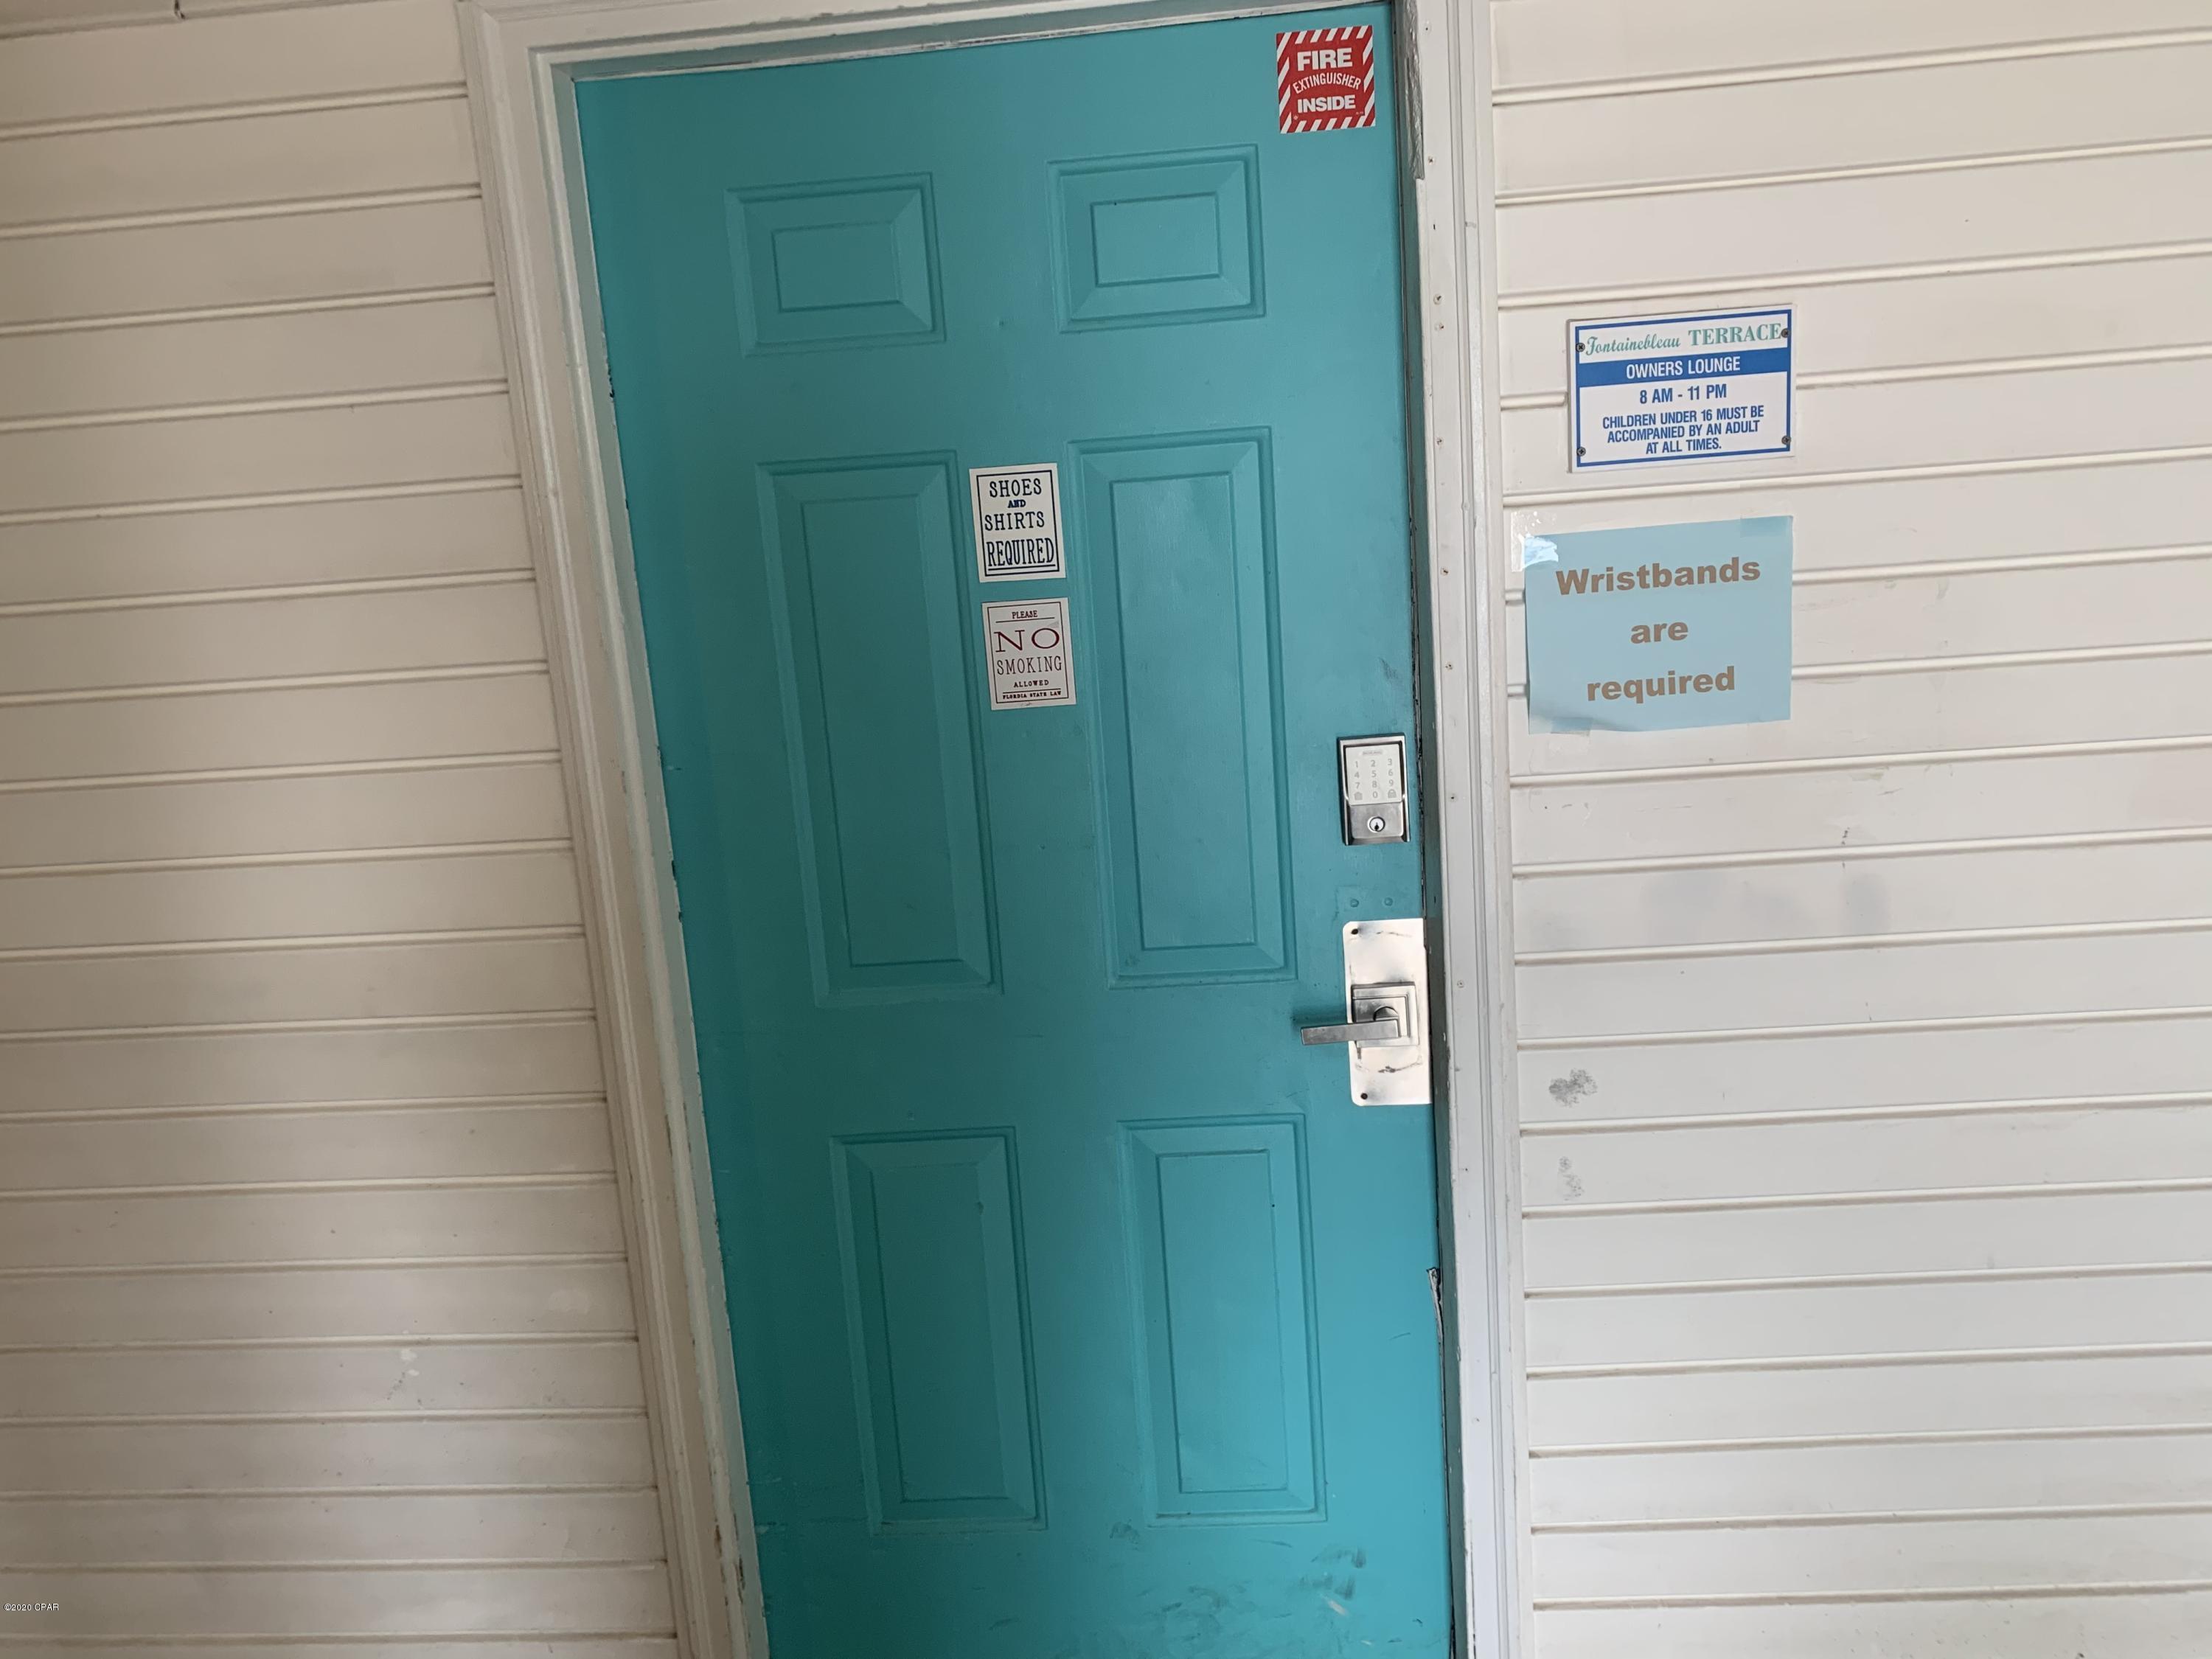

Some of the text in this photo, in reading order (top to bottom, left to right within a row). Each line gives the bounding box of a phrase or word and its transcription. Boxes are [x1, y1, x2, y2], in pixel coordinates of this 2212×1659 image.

[1297, 47, 1353, 72] FIRE
[1293, 72, 1361, 94] EXTINGUISHER
[1298, 94, 1356, 114] INSIDE
[1585, 323, 1782, 355] Fontainebleau TERRACE
[1626, 355, 1740, 379] OWNERS LOUNGE
[1639, 390, 1647, 404] 8
[1652, 388, 1673, 403] AM
[1687, 386, 1700, 400] 11
[1706, 383, 1727, 399] PM
[1602, 405, 1764, 429] CHILDREN UNDER 16 MUST BE
[1607, 420, 1760, 443] ACCOMPANIED BY AN ADULT
[1646, 437, 1722, 454] AT ALL TIMES.
[990, 478, 1042, 498] SHOES
[1007, 499, 1026, 508] AND
[984, 511, 1045, 531] SHIRTS
[987, 538, 1054, 567] REQUIRED
[1556, 557, 1761, 596] Wristbands
[1012, 611, 1037, 619] PLEASE
[993, 627, 1060, 653] NO
[1630, 621, 1688, 644] are
[997, 655, 1062, 675] SMOKING
[1013, 679, 1049, 688] ALLOWED
[1587, 666, 1735, 704] required
[1370, 759, 1376, 768] 2
[1388, 758, 1392, 766] 3
